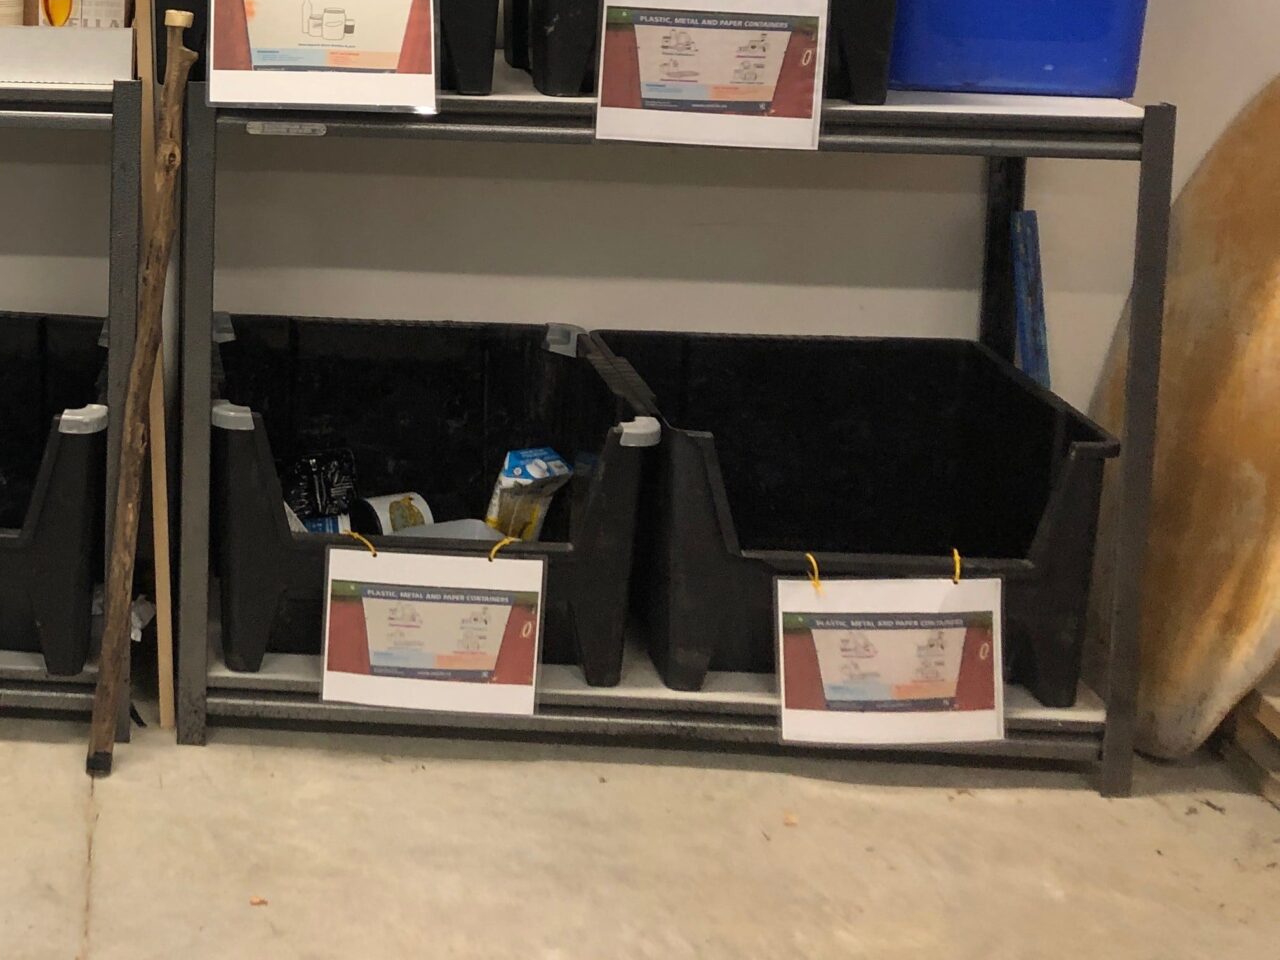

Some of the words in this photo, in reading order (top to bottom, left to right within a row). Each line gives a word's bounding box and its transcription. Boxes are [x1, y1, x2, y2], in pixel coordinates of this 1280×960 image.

[640, 16, 672, 24] PLASTIC,
[674, 17, 699, 25] METAL
[700, 18, 719, 26] AND
[720, 19, 743, 27] PAPER
[744, 20, 788, 29] CONTAINERS
[400, 591, 423, 599] METAL
[466, 595, 509, 603] CONTAINERS
